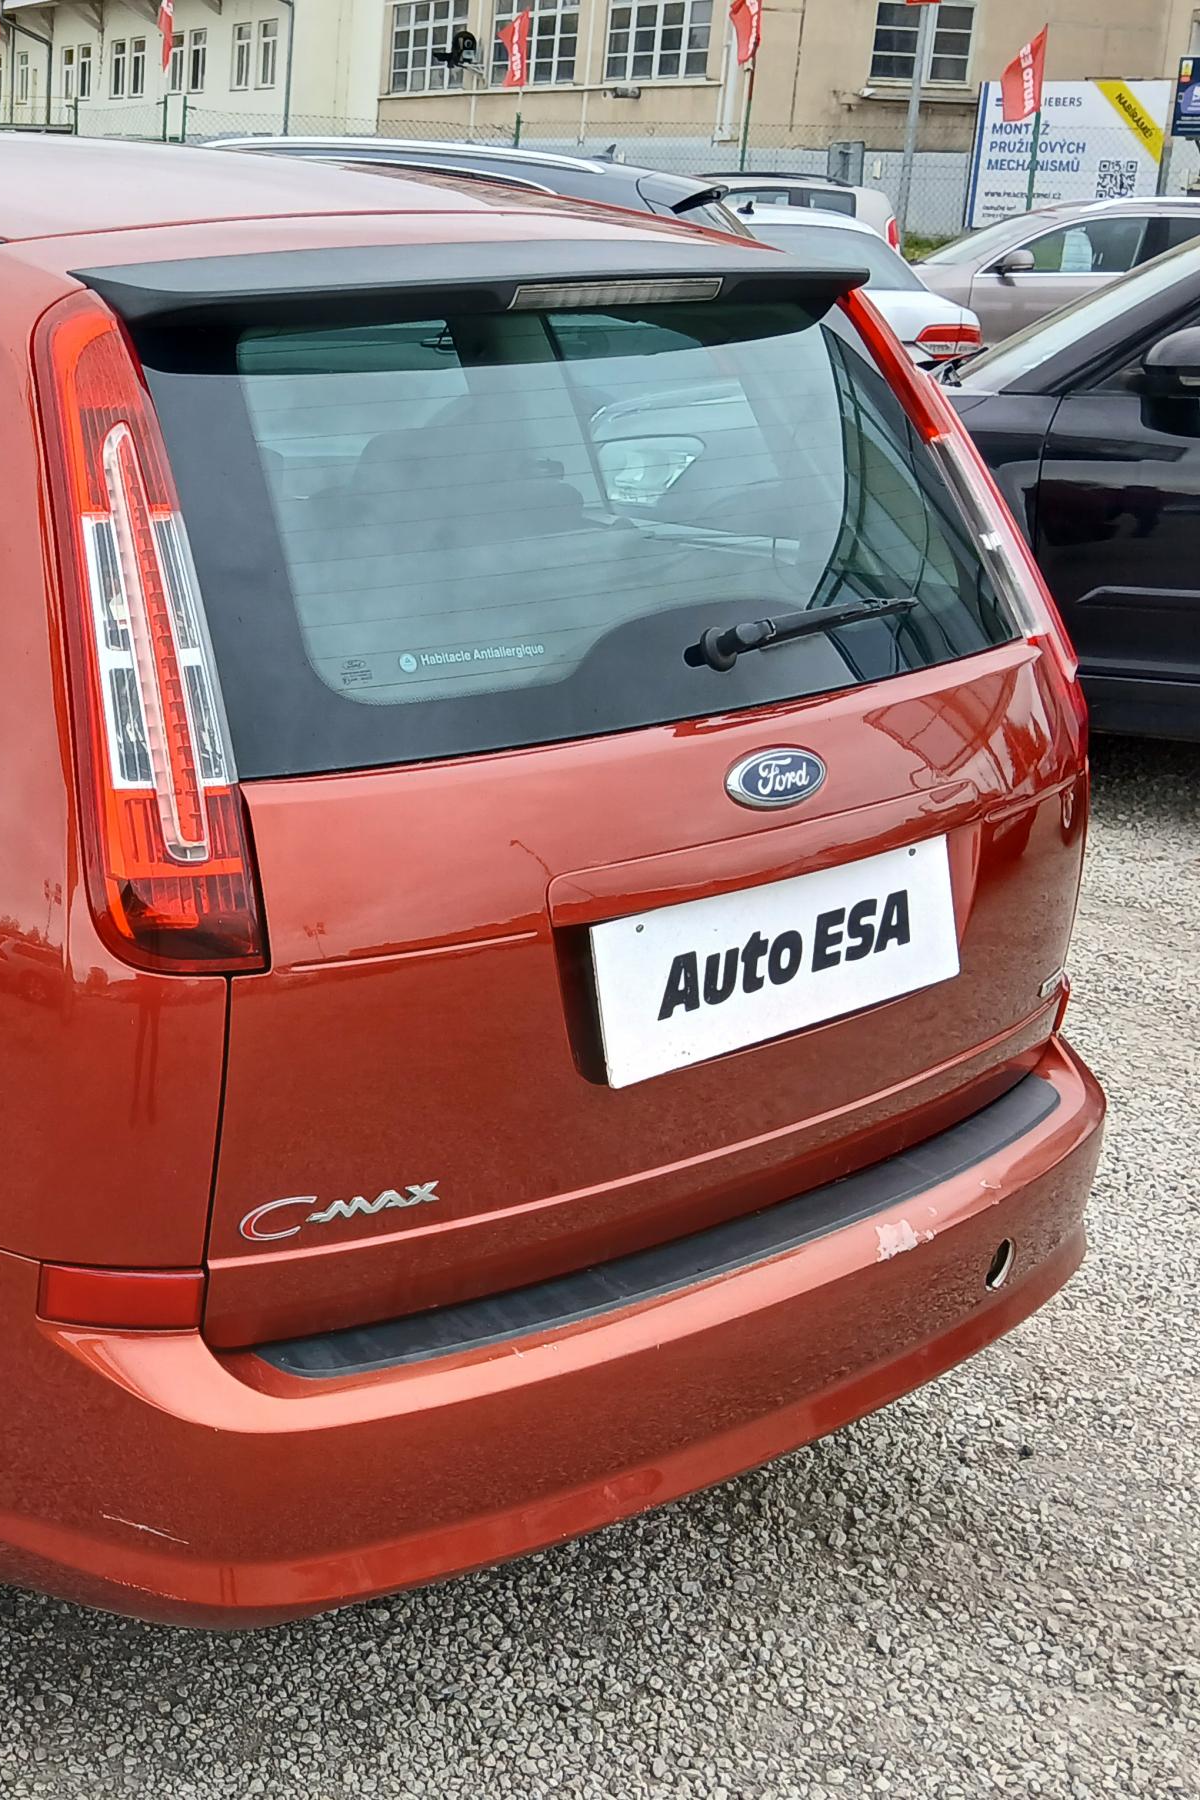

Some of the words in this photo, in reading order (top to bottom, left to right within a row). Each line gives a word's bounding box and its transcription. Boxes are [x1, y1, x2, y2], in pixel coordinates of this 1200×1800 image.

[1040, 97, 1082, 107] IEBERS
[992, 121, 1049, 135] MONTŽ
[989, 139, 1086, 154] PRUŽIOVÝCH
[420, 651, 471, 666] Habitacle
[474, 643, 545, 661] Antiallergique
[757, 756, 810, 795] Ford
[658, 929, 802, 1021] Auto
[811, 890, 911, 972] ESA
